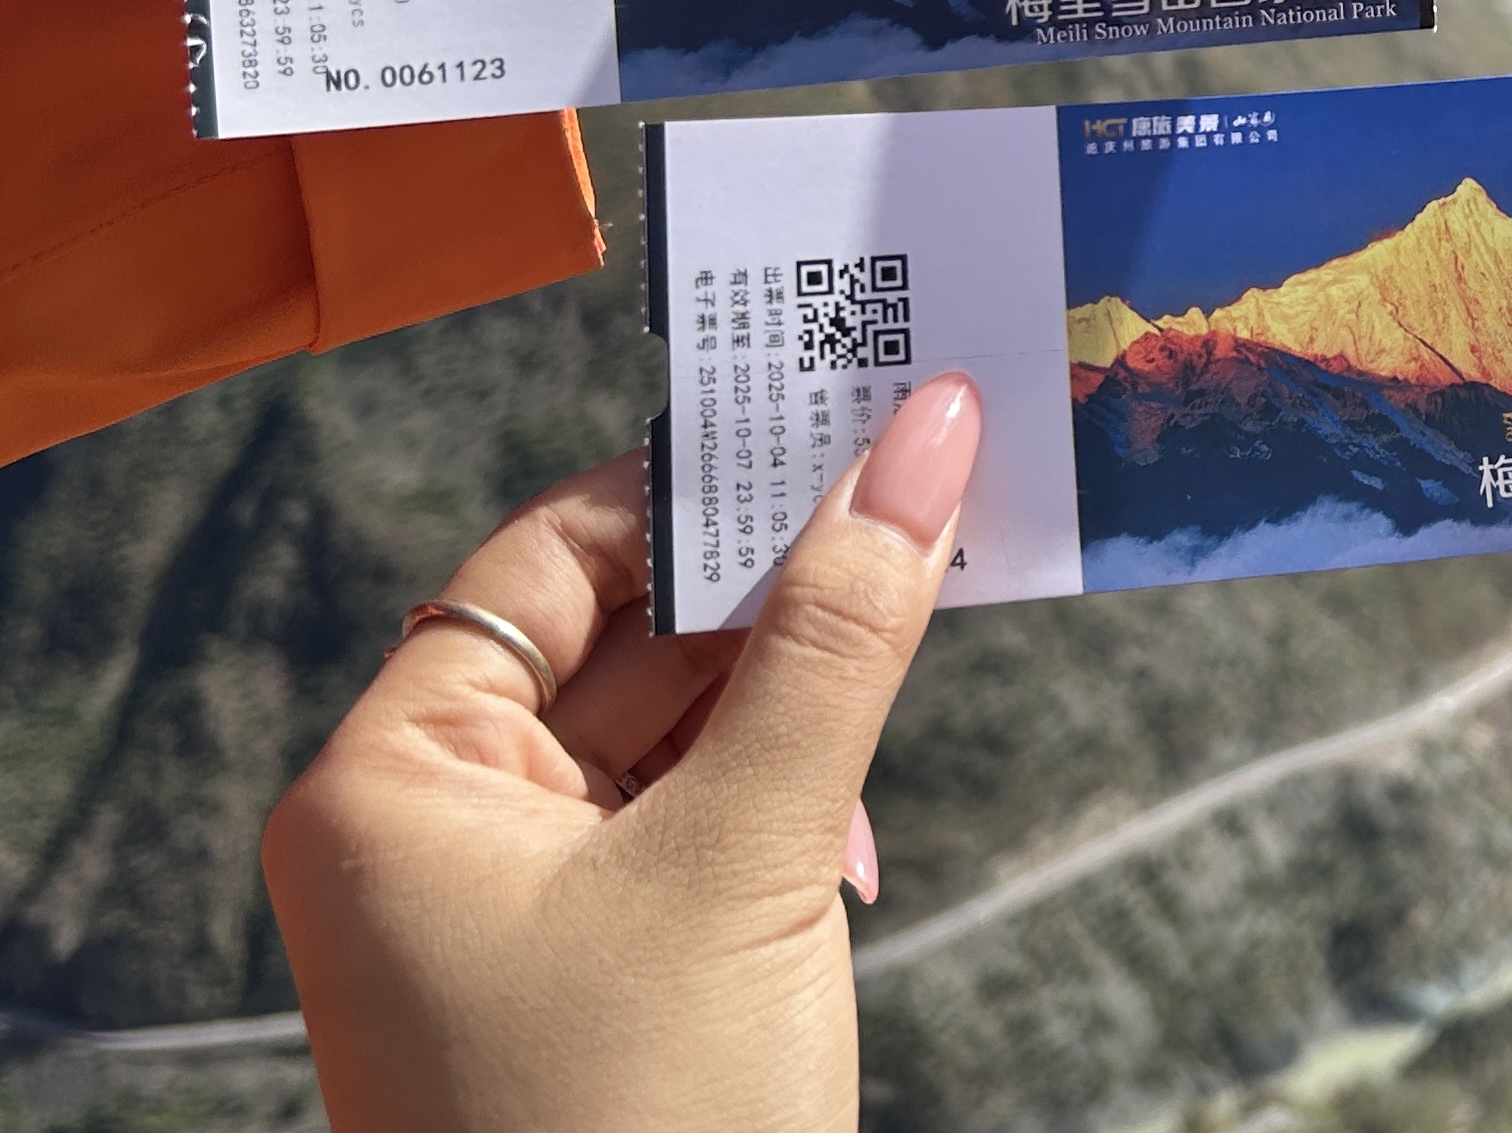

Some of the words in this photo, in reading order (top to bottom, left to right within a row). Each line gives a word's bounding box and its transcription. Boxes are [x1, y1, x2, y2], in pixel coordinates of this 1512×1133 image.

[1036, 23, 1089, 46] Meili
[1094, 19, 1150, 40] Snow
[1157, 12, 1253, 35] Mountain
[1260, 3, 1345, 27] National
[1352, 0, 1398, 20] Park
[851, 385, 873, 457] 票价:55
